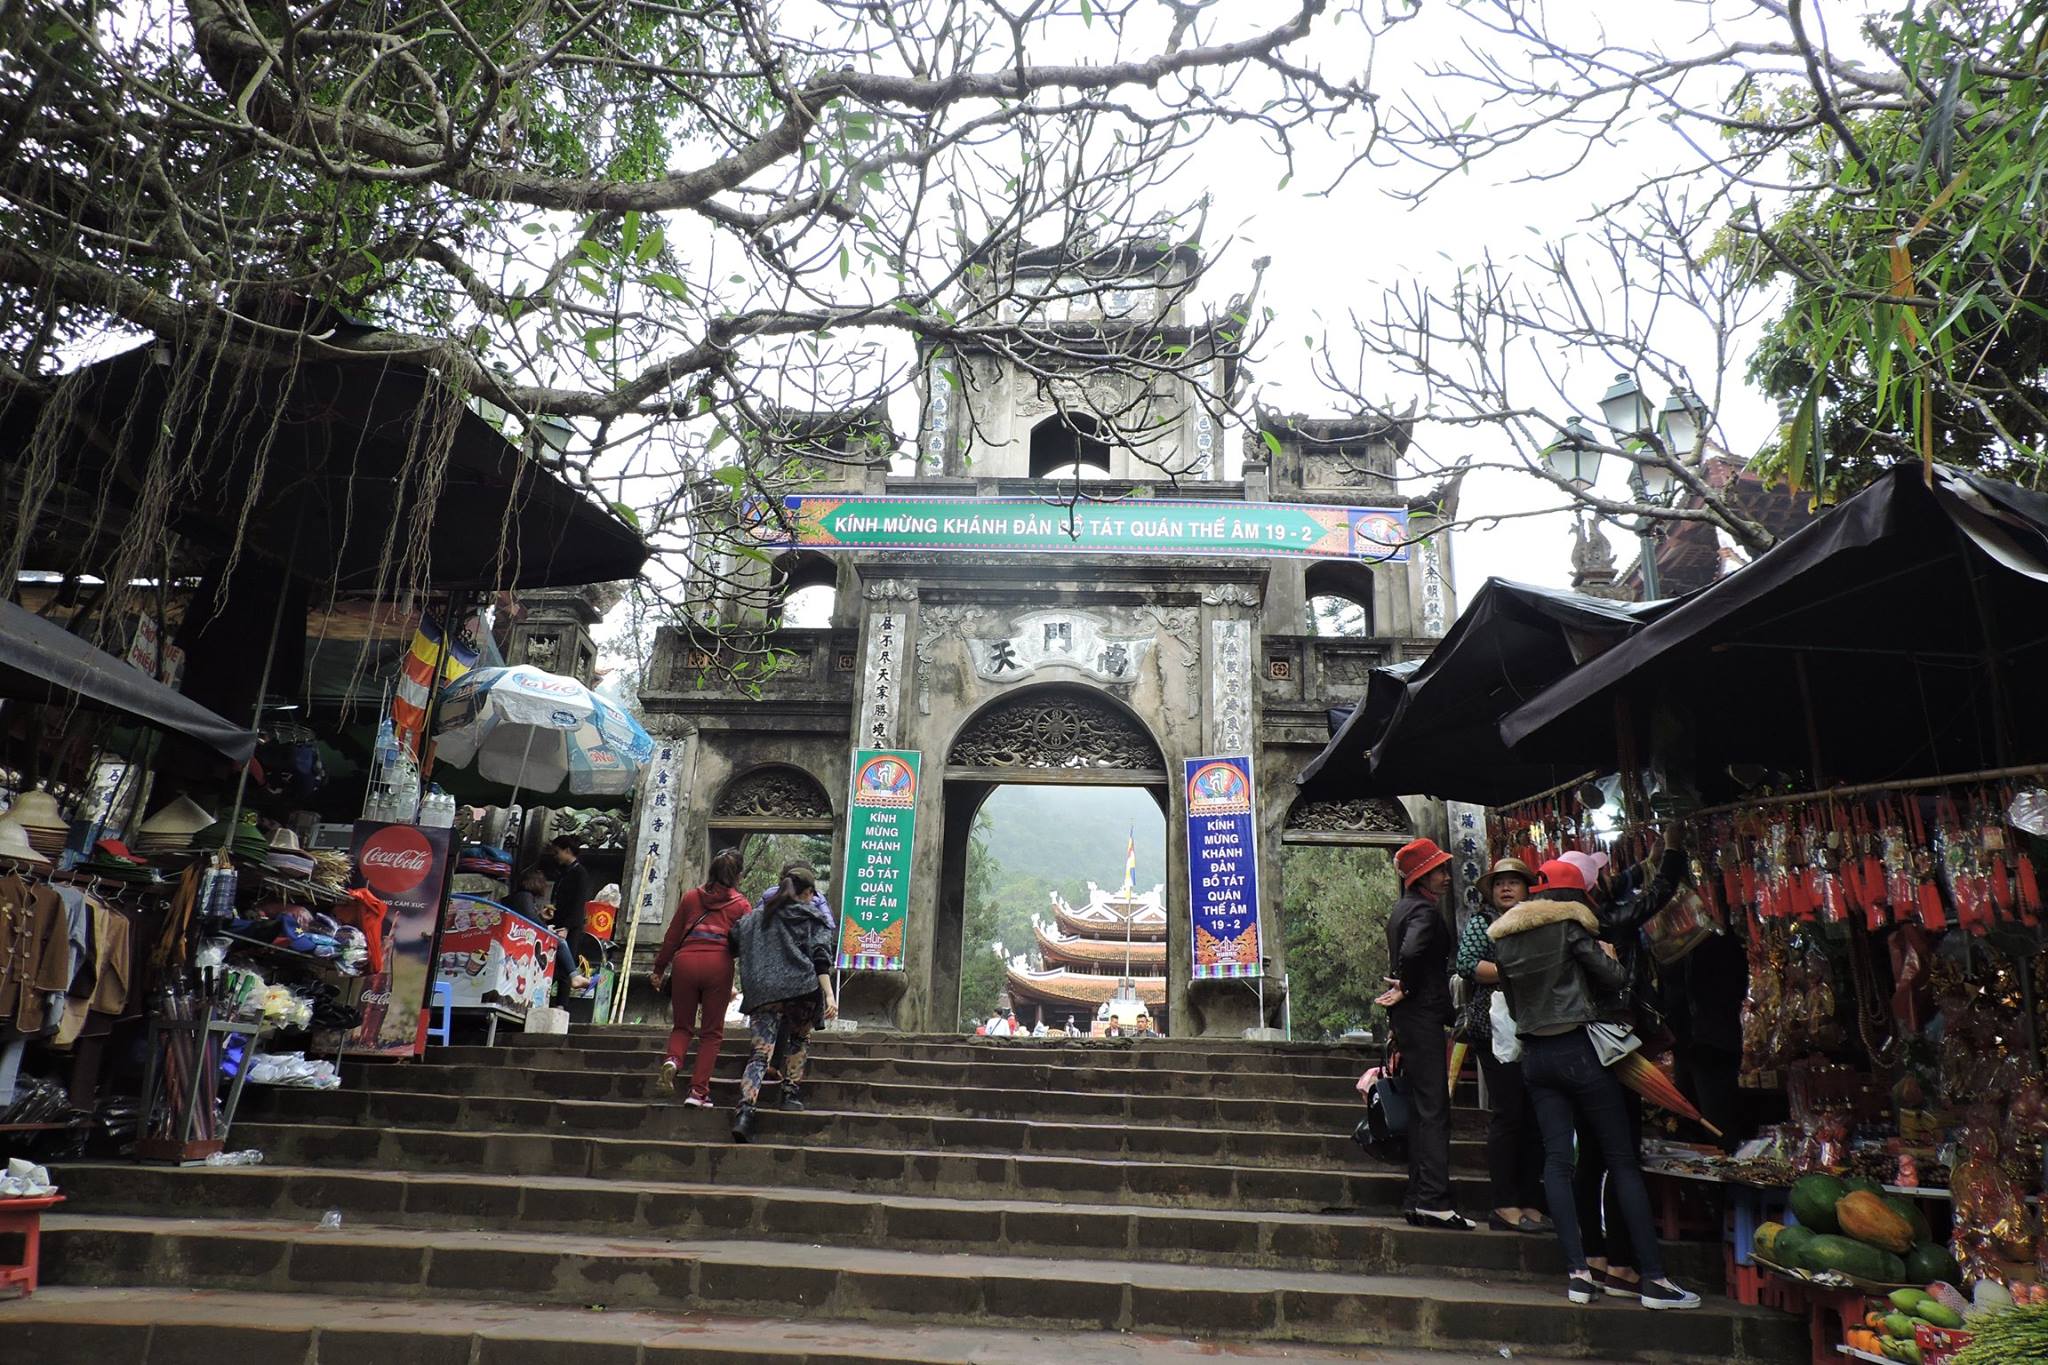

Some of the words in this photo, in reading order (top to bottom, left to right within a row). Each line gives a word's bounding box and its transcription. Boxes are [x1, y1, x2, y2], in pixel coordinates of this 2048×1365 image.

[834, 514, 878, 533] KÍNH
[883, 514, 938, 534] MỪNG
[943, 514, 1007, 534] KHÁNH
[1013, 513, 1052, 535] ĐẢN
[1090, 517, 1126, 536] TÁT
[1130, 517, 1183, 538] QUÁN
[1189, 516, 1225, 538] THẾ
[1231, 517, 1260, 540] ÂM
[1265, 525, 1286, 540] 19
[1301, 526, 1312, 541] 2
[869, 811, 897, 823] KÍNH
[865, 825, 899, 837] MỪNG
[1207, 818, 1235, 831] KÍNH
[861, 839, 901, 851] KHÁNH
[1204, 832, 1239, 845] MỪNG
[867, 852, 892, 865] ĐẢN
[1202, 847, 1243, 860] KHÁNH
[857, 865, 875, 879] BỒ
[877, 867, 900, 879] TÁT
[1211, 859, 1236, 872] ĐẢN
[860, 880, 893, 893] QUÁN
[1203, 874, 1220, 887] BỒ
[1223, 874, 1245, 887] TÁT
[854, 894, 876, 907] THẾ
[879, 896, 897, 908] ÂM
[1207, 889, 1241, 902] QUÁN
[1203, 902, 1226, 915] THẾ
[1229, 903, 1247, 915] ÂM
[860, 911, 873, 921] 19
[882, 912, 889, 922] 2
[1211, 920, 1224, 930] 19
[1233, 919, 1241, 929] 2
